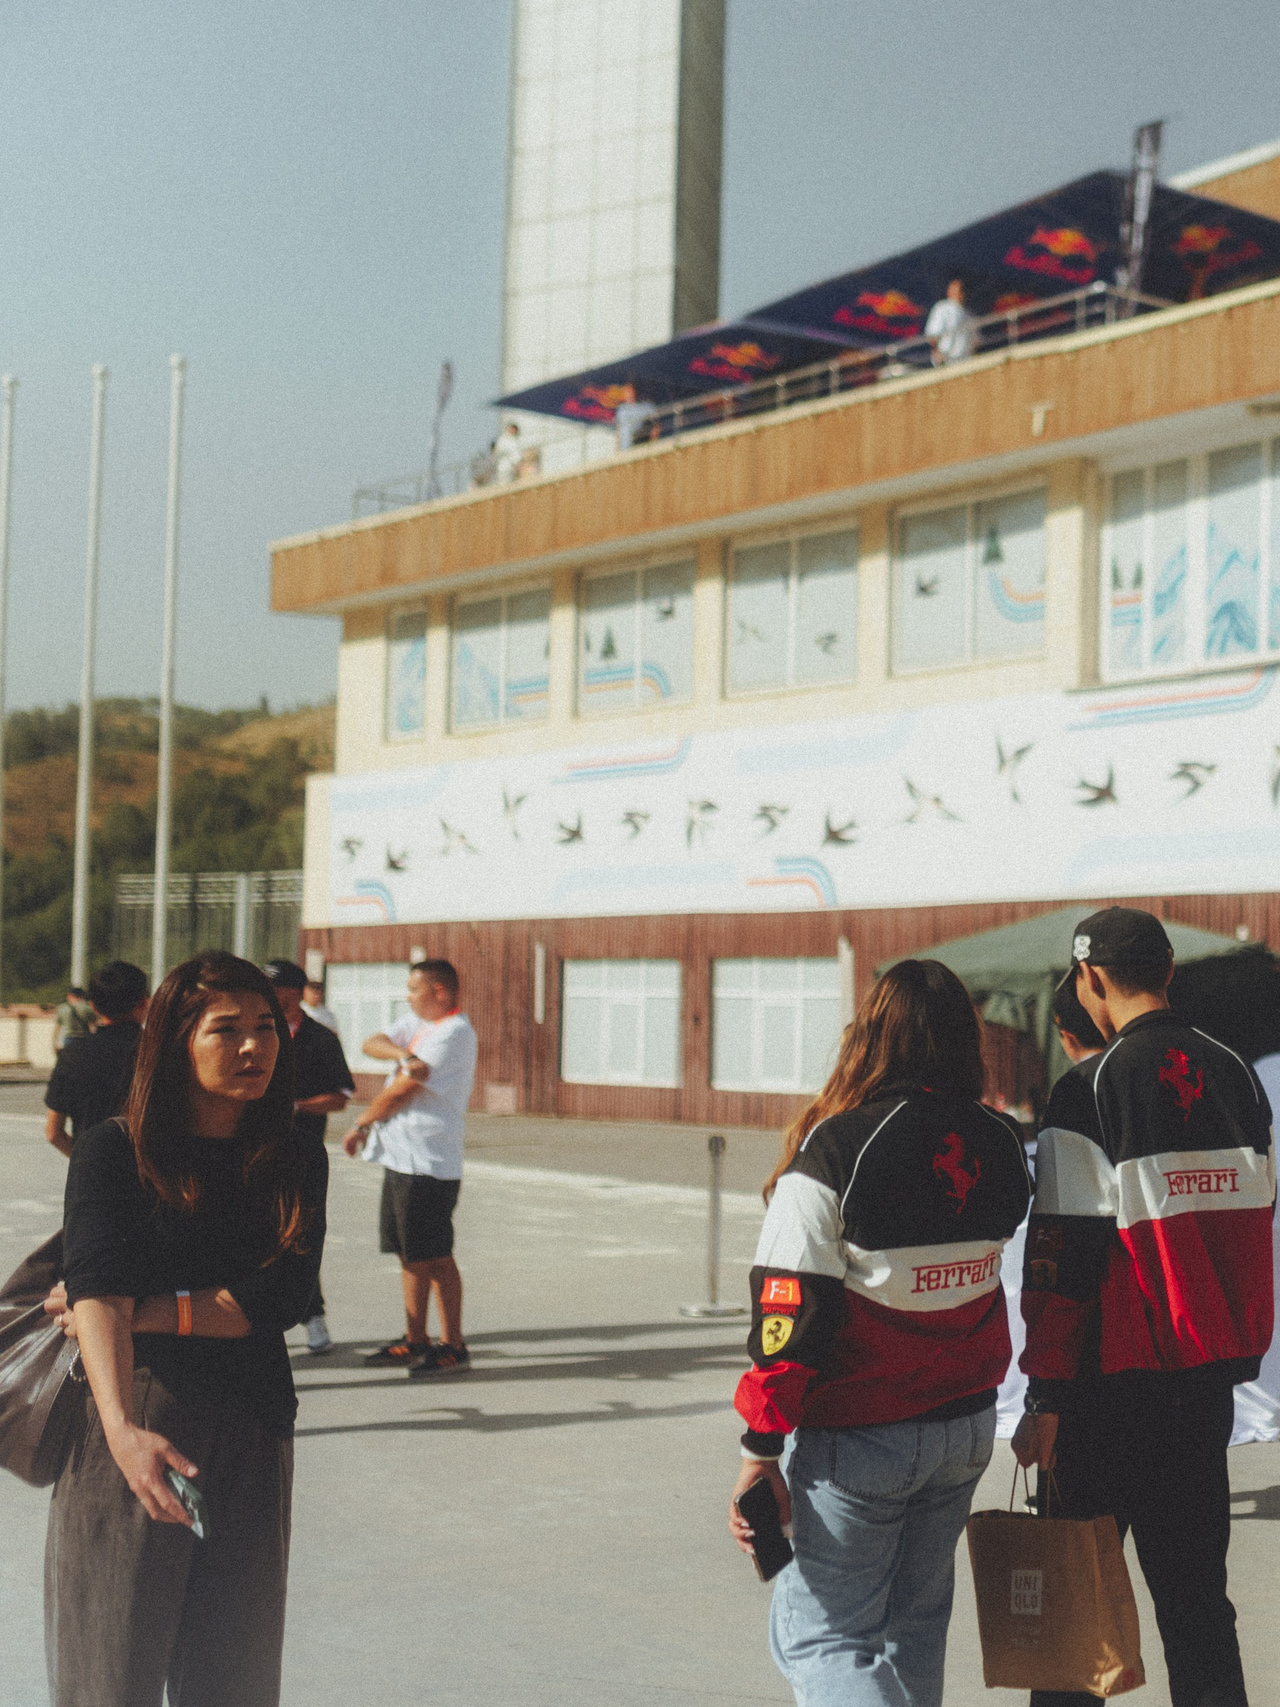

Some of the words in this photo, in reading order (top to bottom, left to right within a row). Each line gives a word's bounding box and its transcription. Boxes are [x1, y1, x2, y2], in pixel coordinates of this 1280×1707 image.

[1162, 1168, 1240, 1197] Ferari
[911, 1252, 996, 1294] Ferrari
[769, 1281, 793, 1302] F-1
[1015, 1575, 1038, 1591] UNI
[1015, 1593, 1038, 1611] QLO
